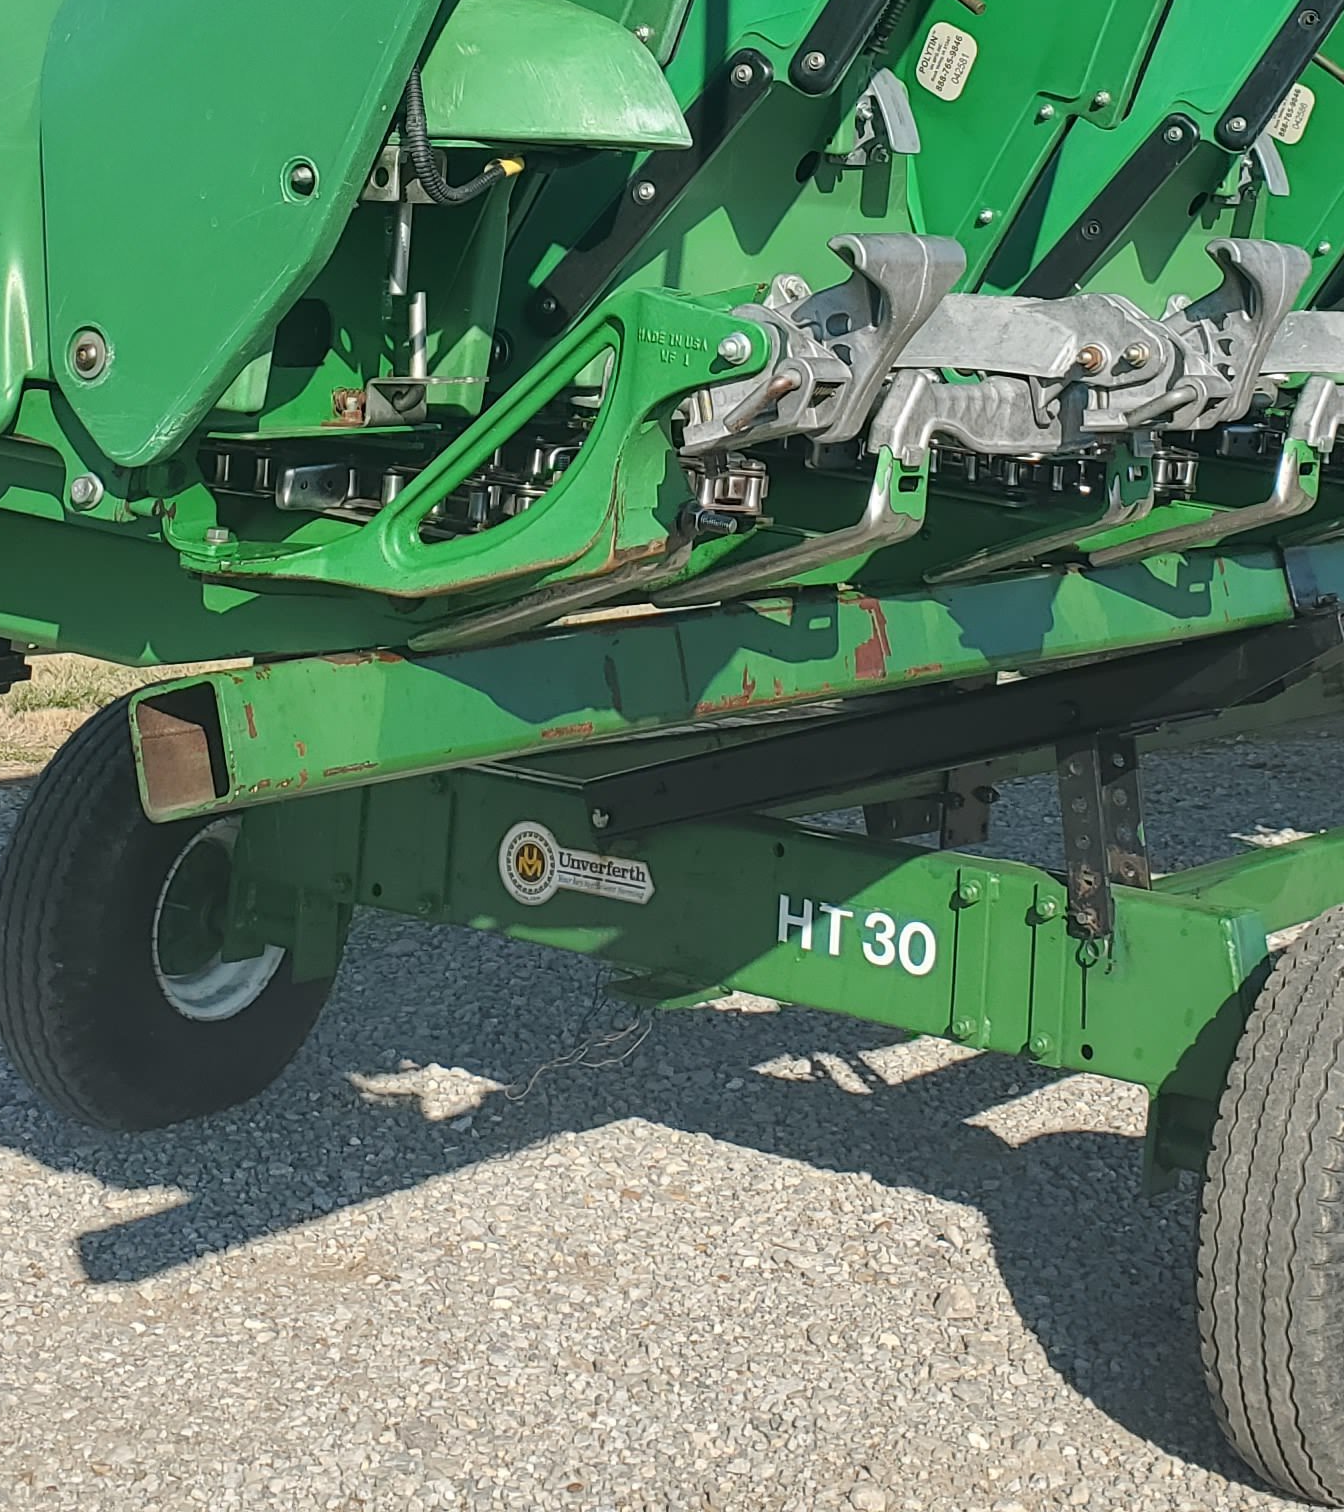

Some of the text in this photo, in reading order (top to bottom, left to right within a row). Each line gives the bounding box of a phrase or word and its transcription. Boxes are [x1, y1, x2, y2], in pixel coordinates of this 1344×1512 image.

[935, 35, 963, 92] 888-765-9846
[637, 327, 708, 352] MADE IN USA
[558, 850, 647, 883] Unverferth
[777, 893, 936, 976] HT 30
